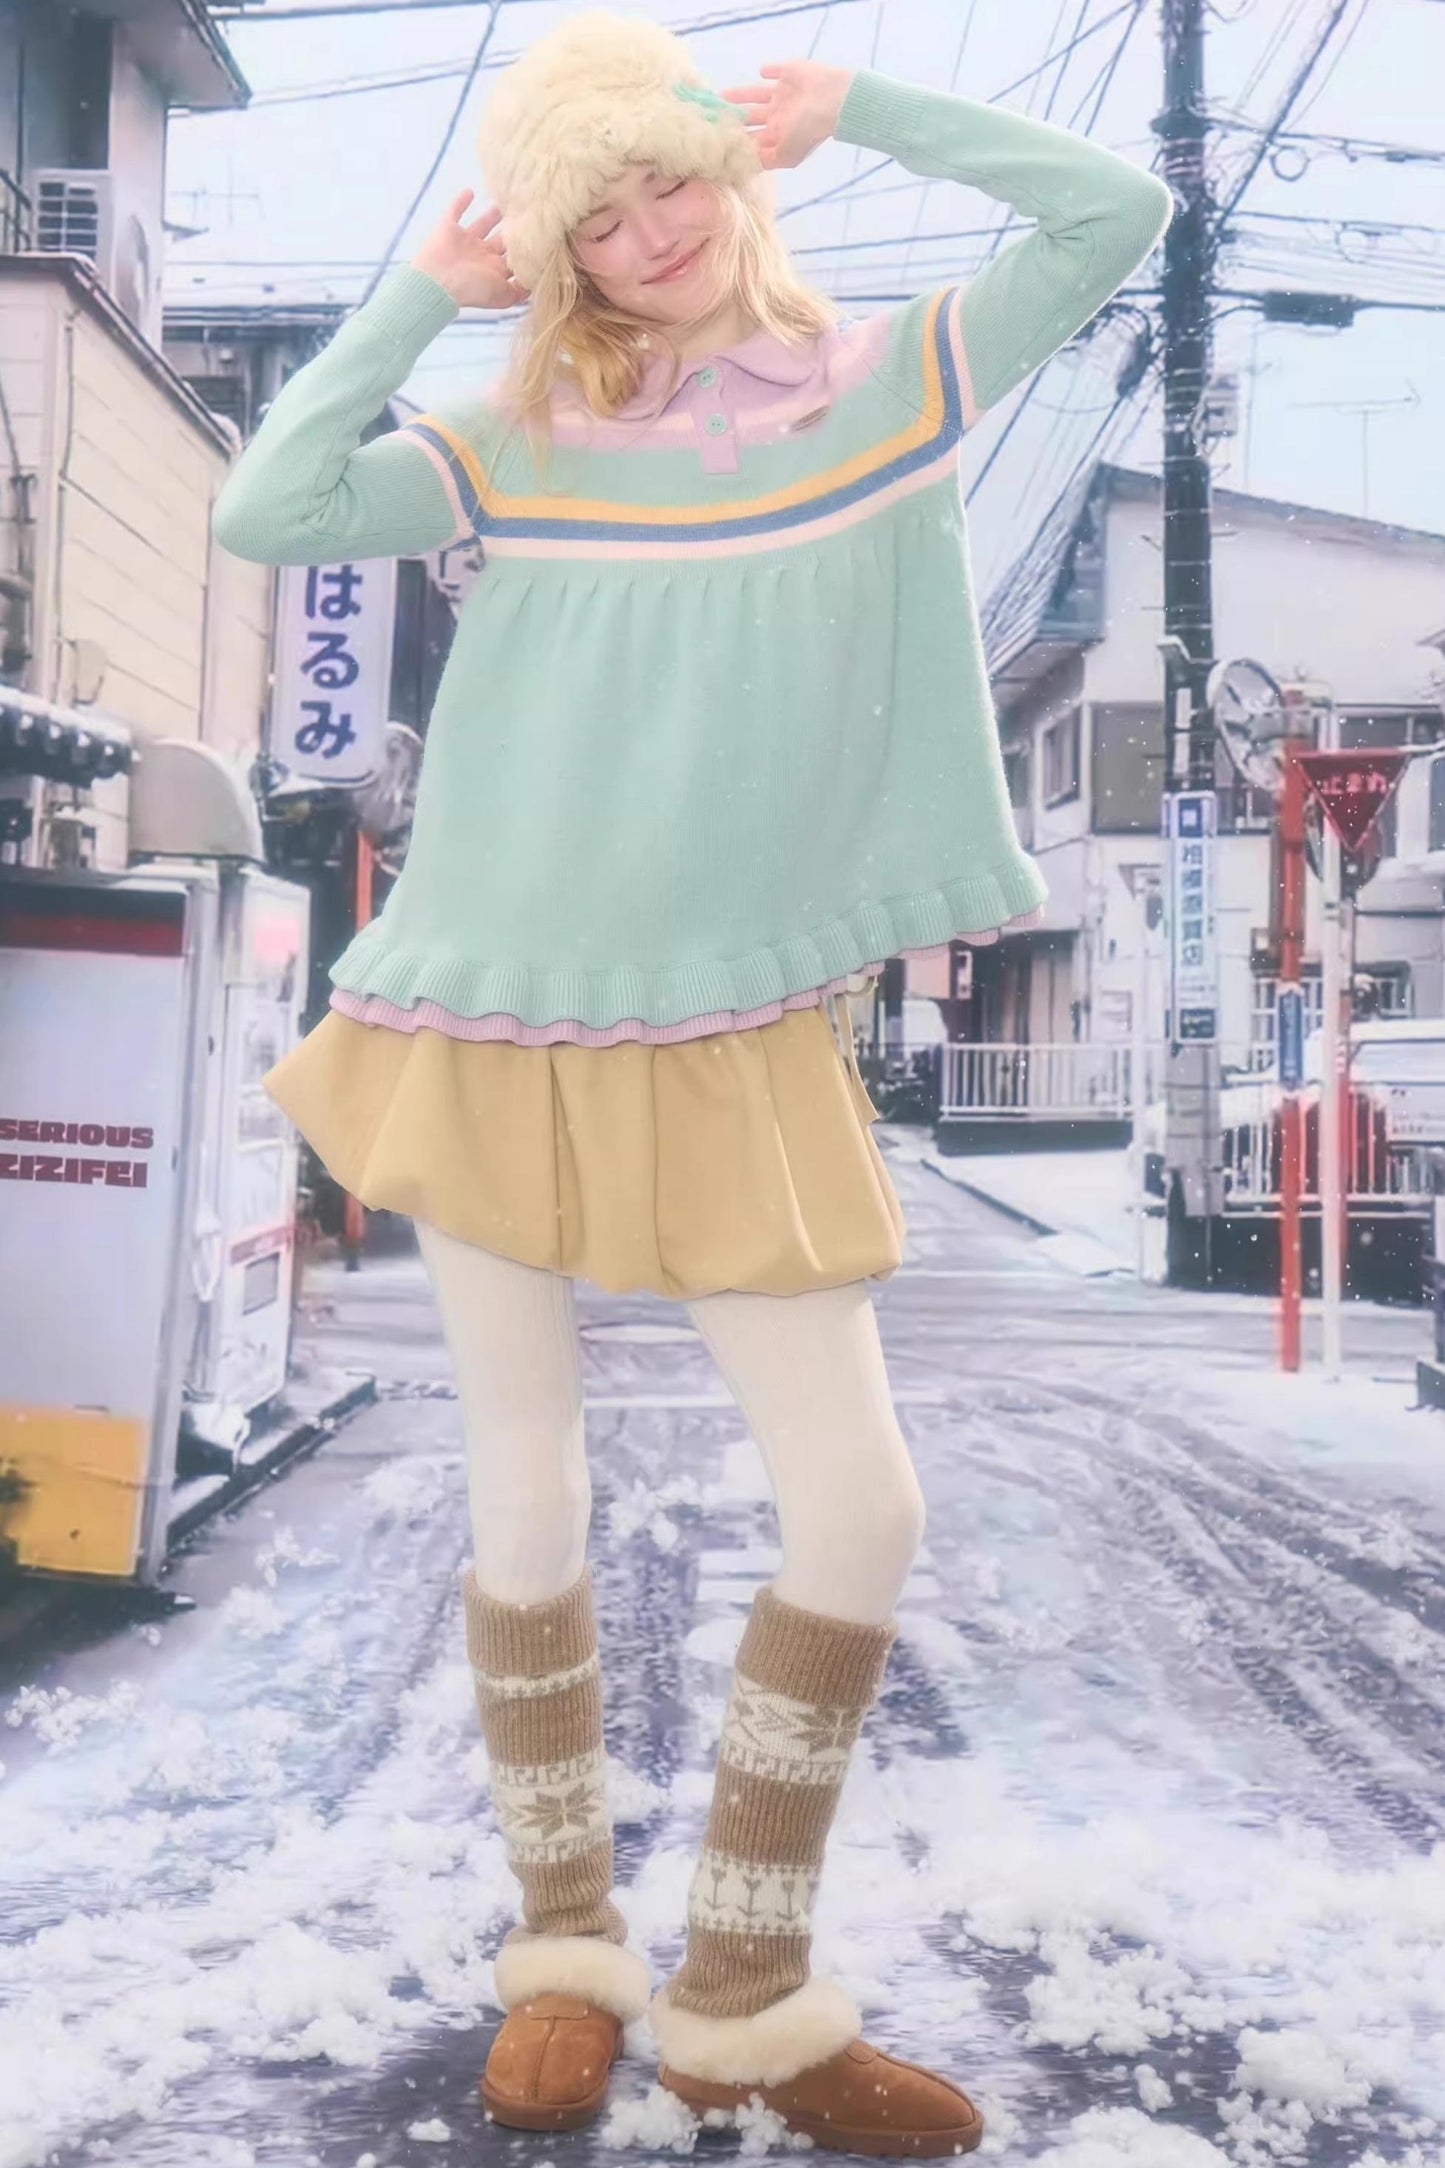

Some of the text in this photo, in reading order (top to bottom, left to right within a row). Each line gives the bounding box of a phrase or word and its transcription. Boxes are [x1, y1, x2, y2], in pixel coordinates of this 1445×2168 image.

[295, 564, 363, 759] はるみ
[0, 1118, 154, 1149] SERIOUS
